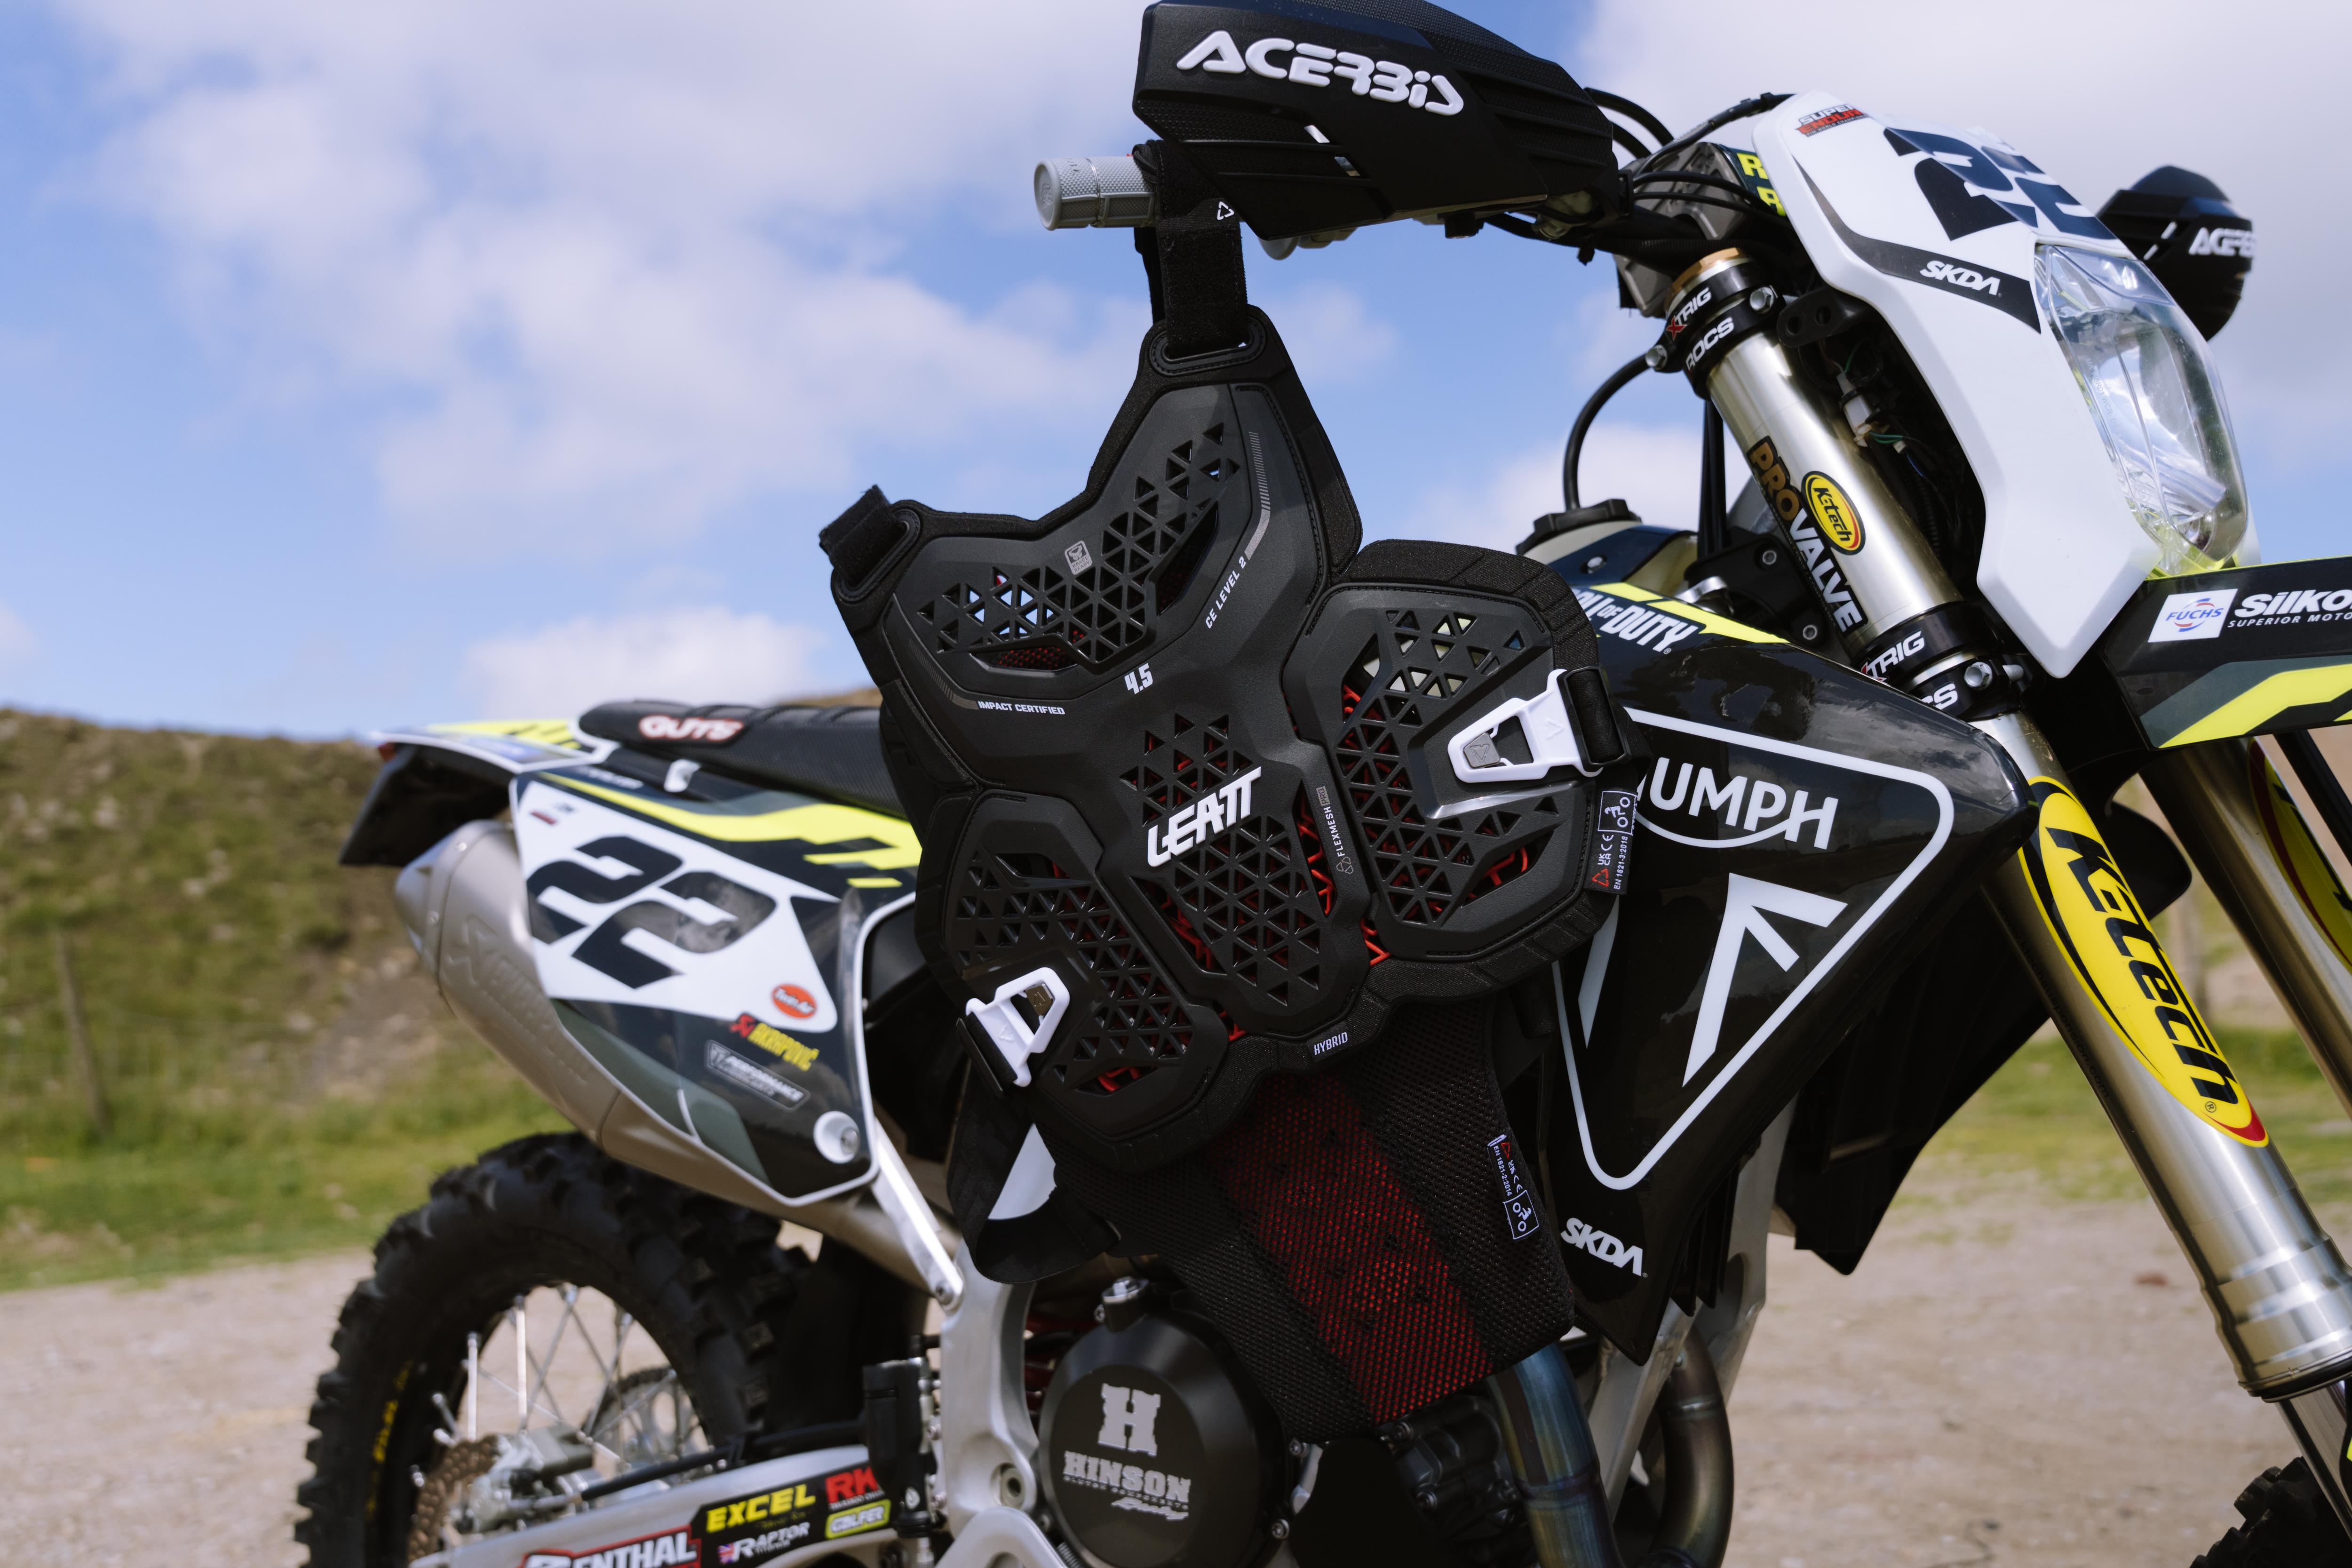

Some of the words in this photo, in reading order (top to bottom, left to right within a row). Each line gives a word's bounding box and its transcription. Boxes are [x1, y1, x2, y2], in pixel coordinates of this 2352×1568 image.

[1798, 109, 1867, 134] ENDUR
[1799, 104, 1856, 125] SUPE
[1920, 260, 2001, 296] SKDA
[1666, 287, 1712, 341] XTRIG
[1685, 317, 1734, 370] ROCS
[1205, 608, 1217, 629] CE
[1216, 570, 1240, 610] LEVEL
[1239, 556, 1247, 569] 2
[1597, 604, 1624, 619] OF
[1599, 605, 1699, 653] DUTY
[2165, 607, 2224, 621] FUCHS
[2227, 616, 2301, 628] SUPERIOR
[2307, 613, 2352, 623] MOTO
[1124, 662, 1153, 695] 4.5
[977, 700, 1012, 712] IMPACT
[1015, 703, 1065, 715] CERTIFIED
[1318, 787, 1329, 804] PRO
[1637, 757, 1839, 850] UMPH
[1147, 766, 1262, 868] LEATT
[1323, 806, 1345, 858] FLEXMESH
[1616, 836, 1629, 877] 1621-3:2018
[1613, 879, 1621, 890] EN
[526, 836, 777, 989] 22
[1314, 1032, 1348, 1055] HYBRID
[1494, 1145, 1501, 1156] EN
[1560, 1218, 1644, 1276] SKDA
[1063, 1450, 1192, 1503] HINSON
[707, 1483, 816, 1534] EXCEL
[732, 1521, 811, 1562] RAPTOR
